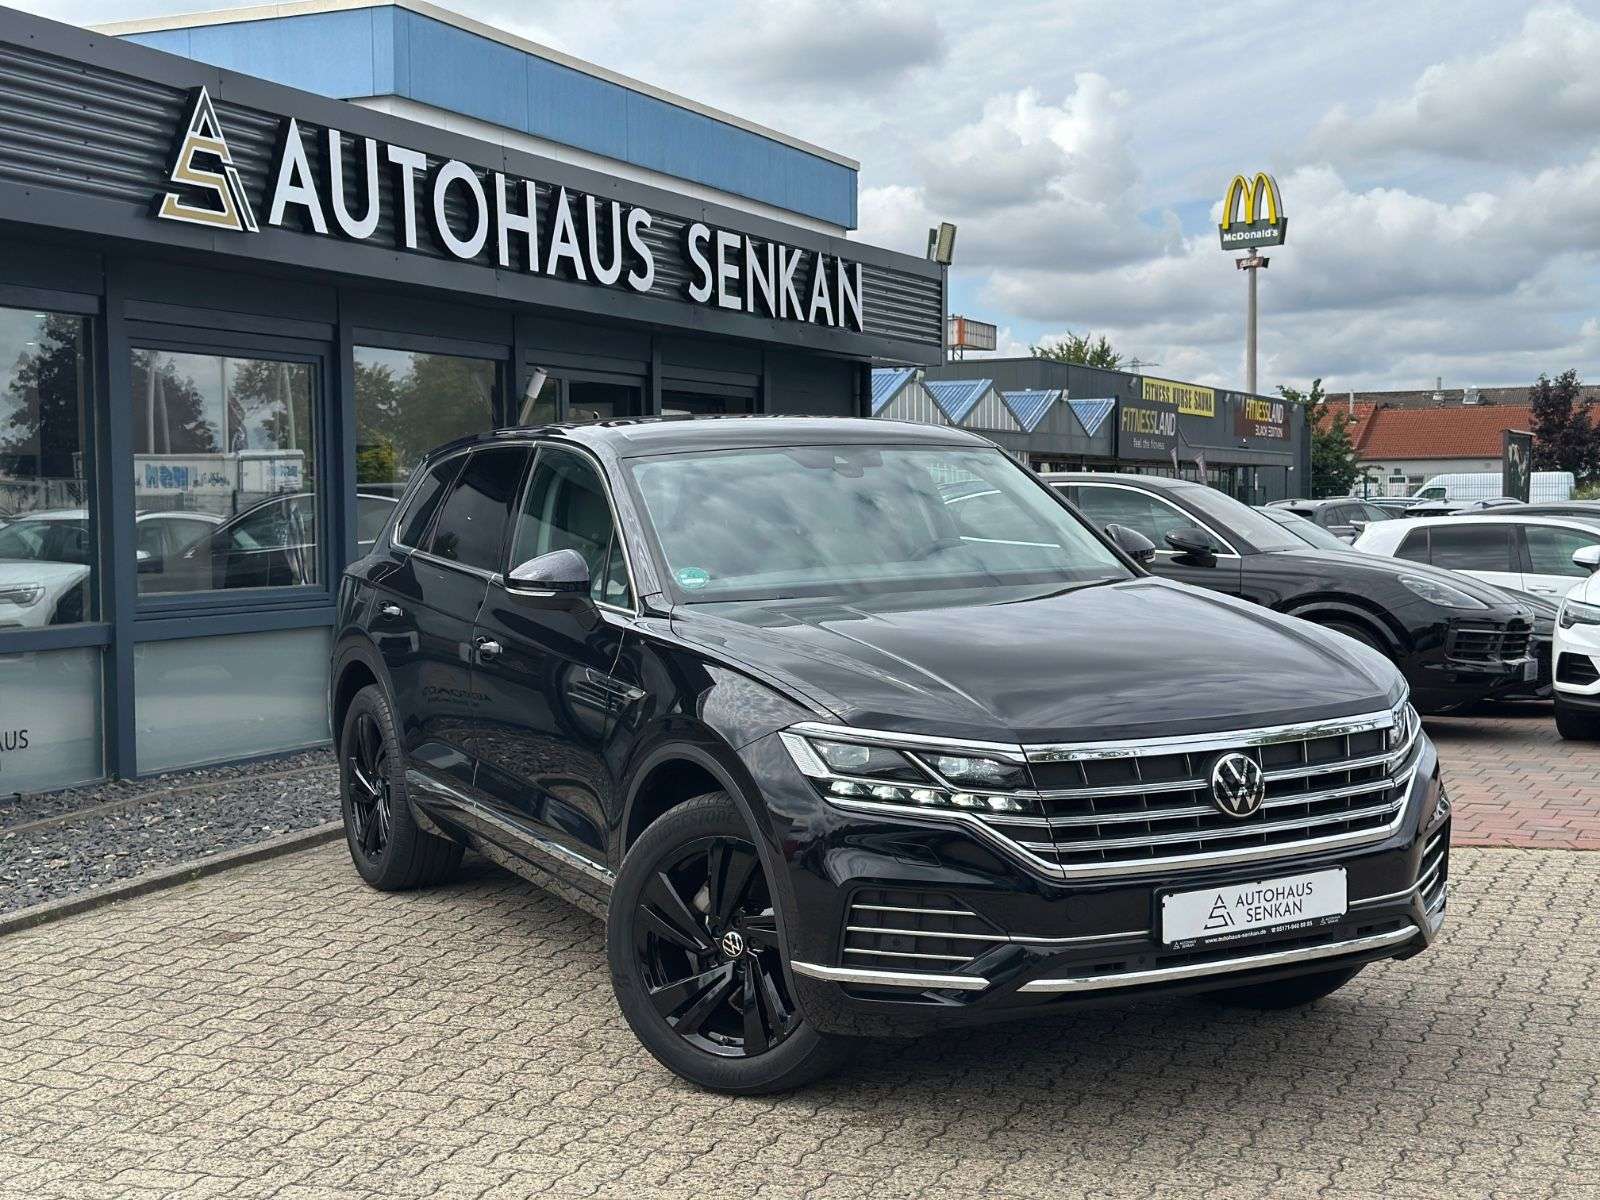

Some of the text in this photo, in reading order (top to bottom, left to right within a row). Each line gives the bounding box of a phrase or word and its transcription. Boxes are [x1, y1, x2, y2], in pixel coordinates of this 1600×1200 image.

[268, 116, 864, 332] AUTOHAUS SENKAN
[1222, 228, 1279, 242] McDonald's
[1121, 407, 1176, 436] FITNESSLAND
[1236, 882, 1313, 908] AUTOHAUS
[1246, 898, 1302, 923] SENKAN
